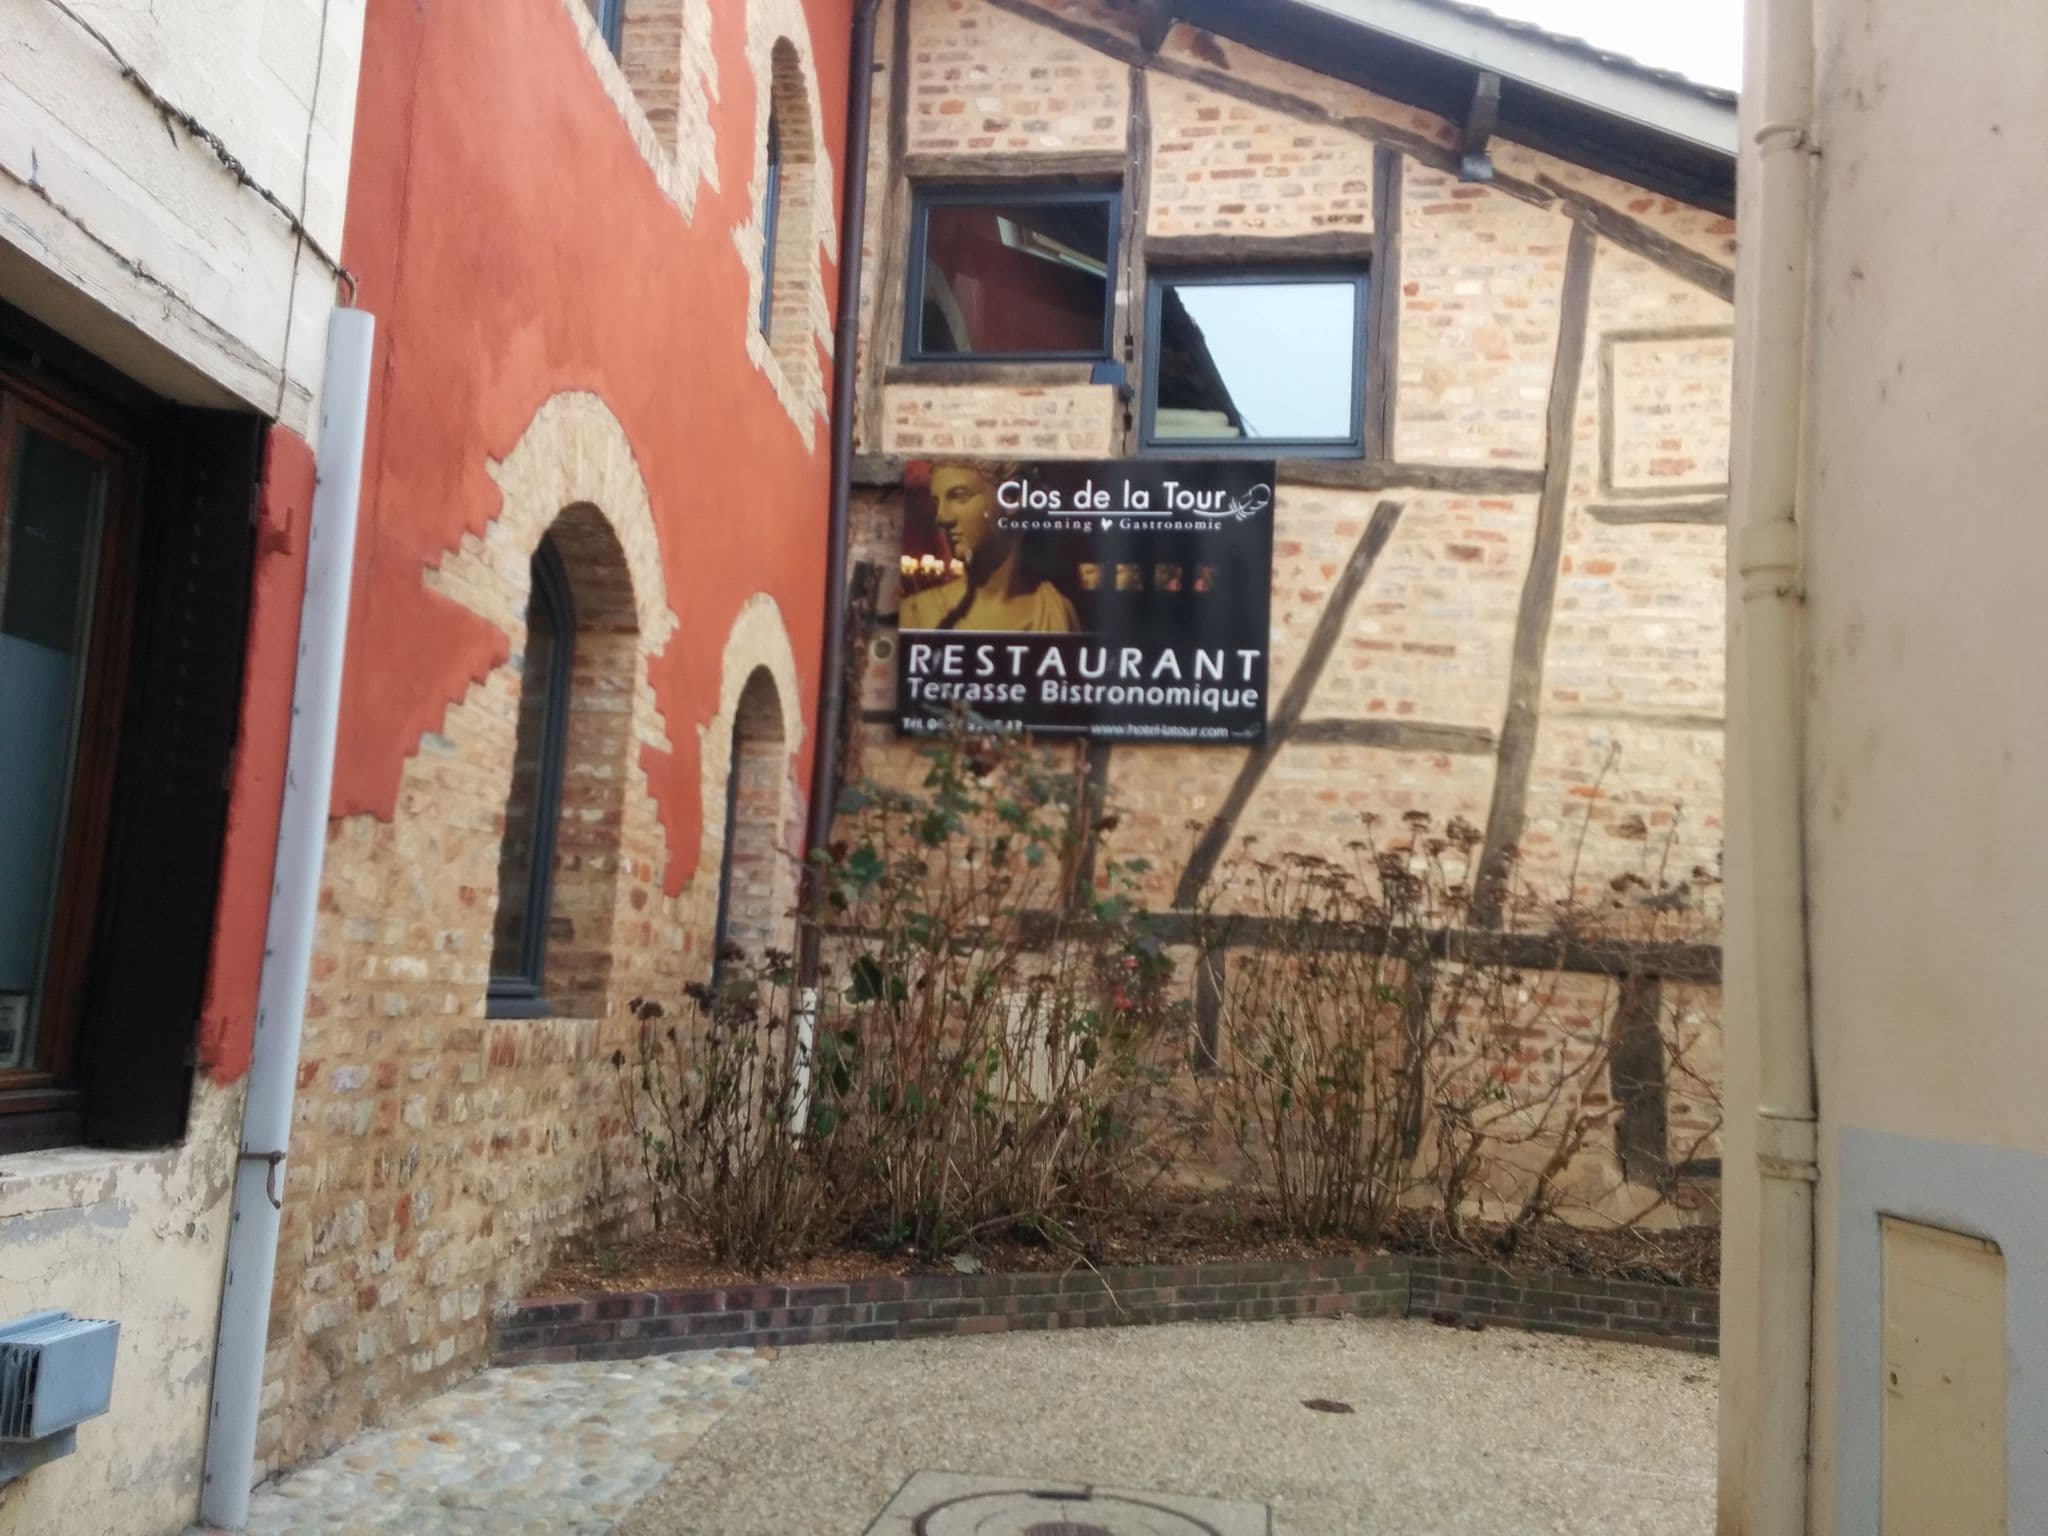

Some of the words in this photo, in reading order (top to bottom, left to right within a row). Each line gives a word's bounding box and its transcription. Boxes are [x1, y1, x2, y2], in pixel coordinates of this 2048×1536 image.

[997, 480, 1061, 509] Clos
[1074, 480, 1111, 509] de
[1123, 480, 1149, 509] la
[1162, 480, 1227, 509] Tour
[998, 517, 1093, 532] Cocooning
[1119, 518, 1223, 531] Gastronomie
[908, 643, 1262, 681] RESTAURANT
[906, 677, 1027, 703] Terrasse
[1041, 679, 1259, 713] Bistronomique
